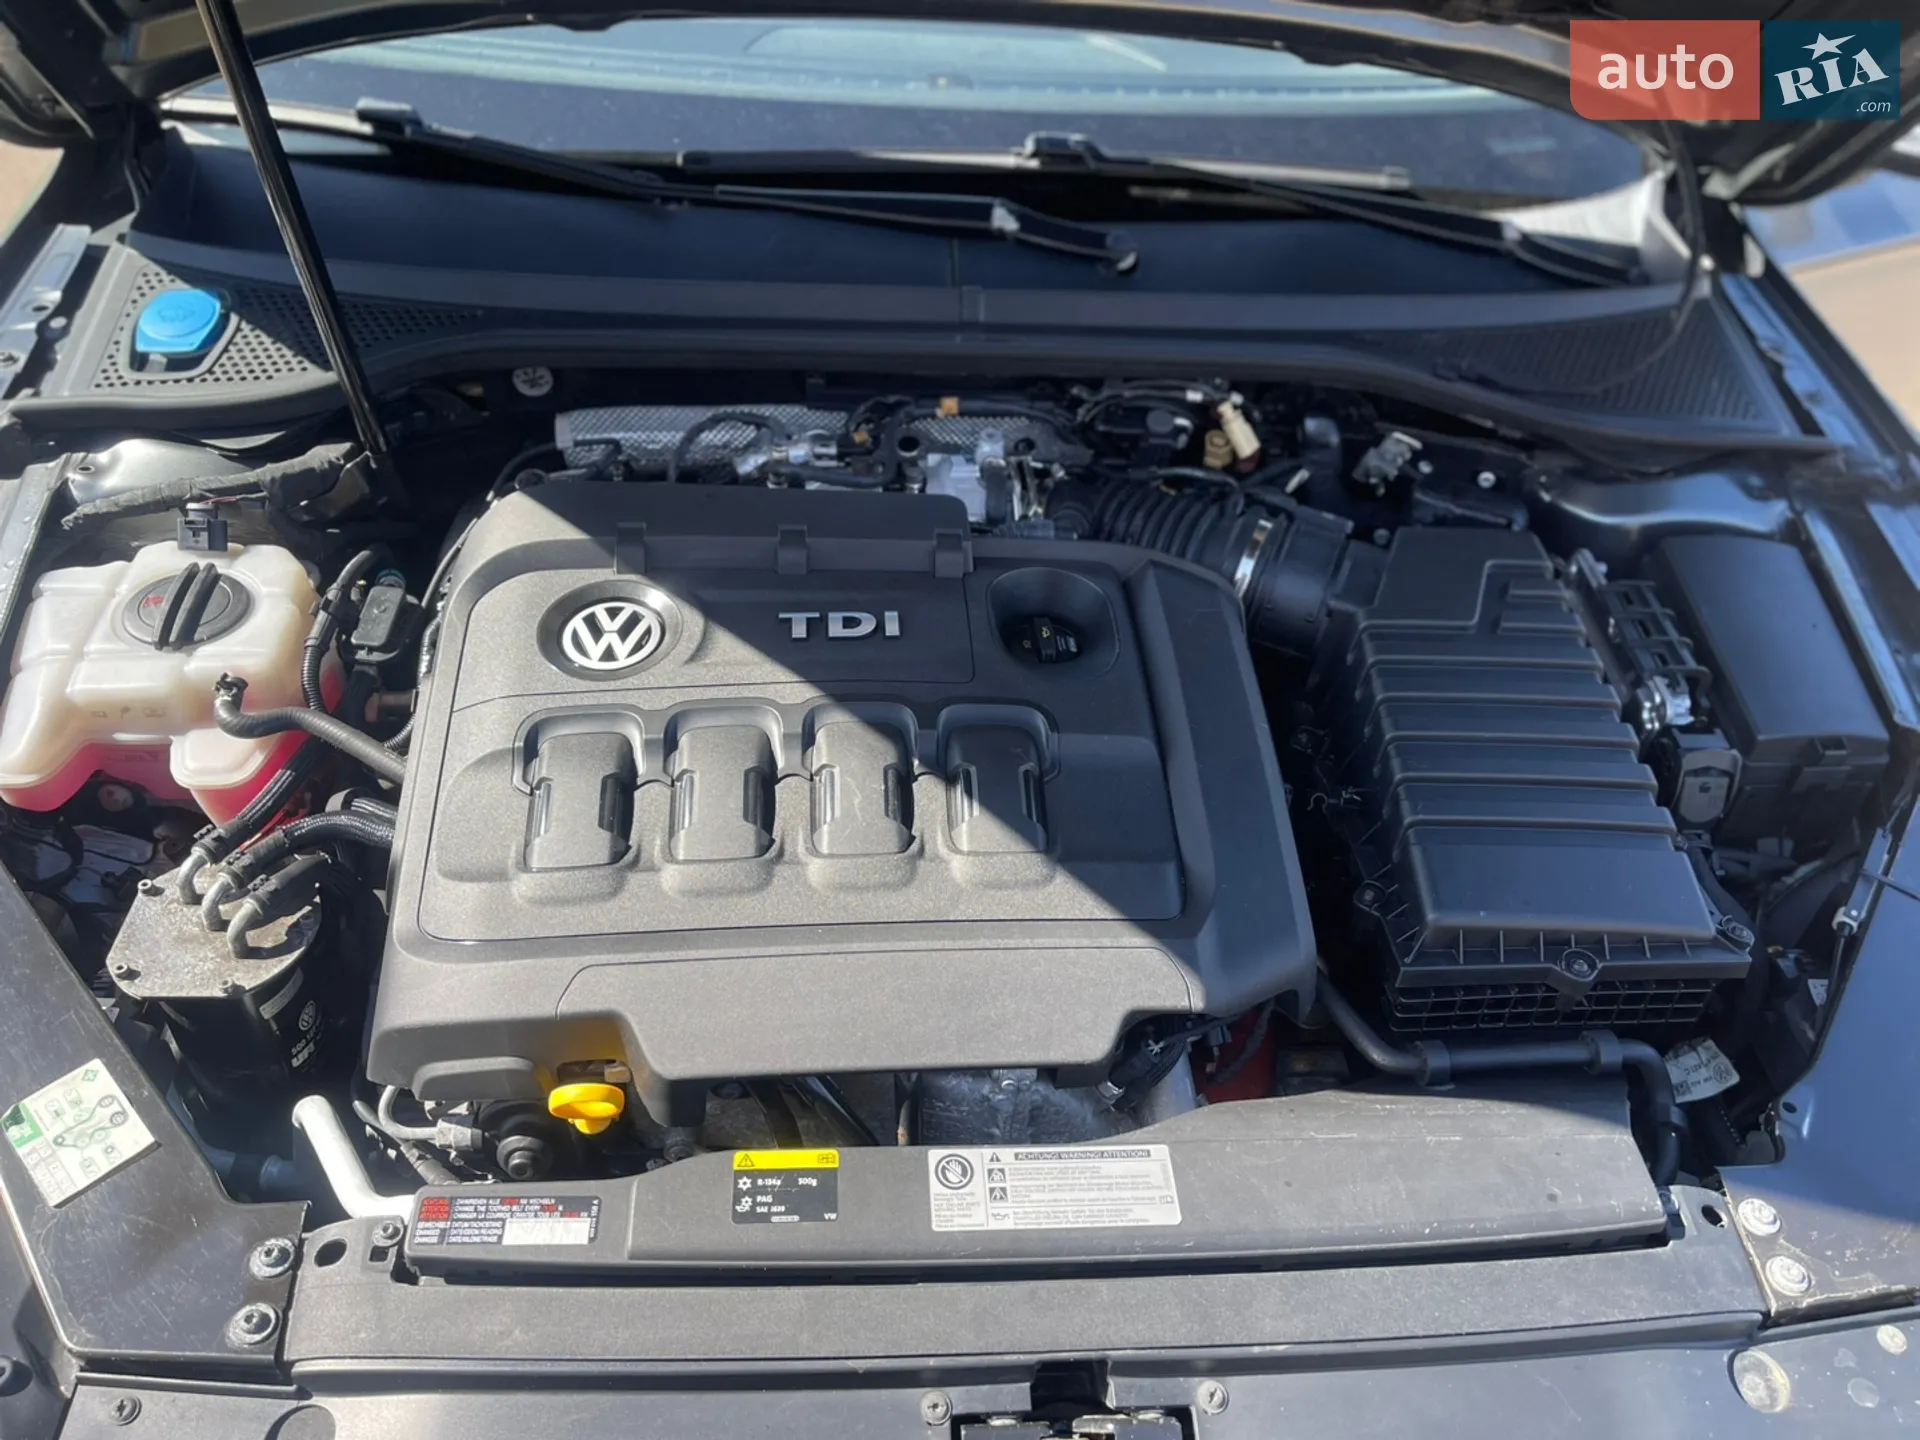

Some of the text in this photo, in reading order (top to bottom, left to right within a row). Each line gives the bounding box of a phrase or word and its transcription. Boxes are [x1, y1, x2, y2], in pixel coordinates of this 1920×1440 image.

[778, 610, 900, 639] TDI
[1018, 1149, 1149, 1160] ACHTUNG! WARNING! ATTENTION!
[756, 1195, 773, 1203] PAG
